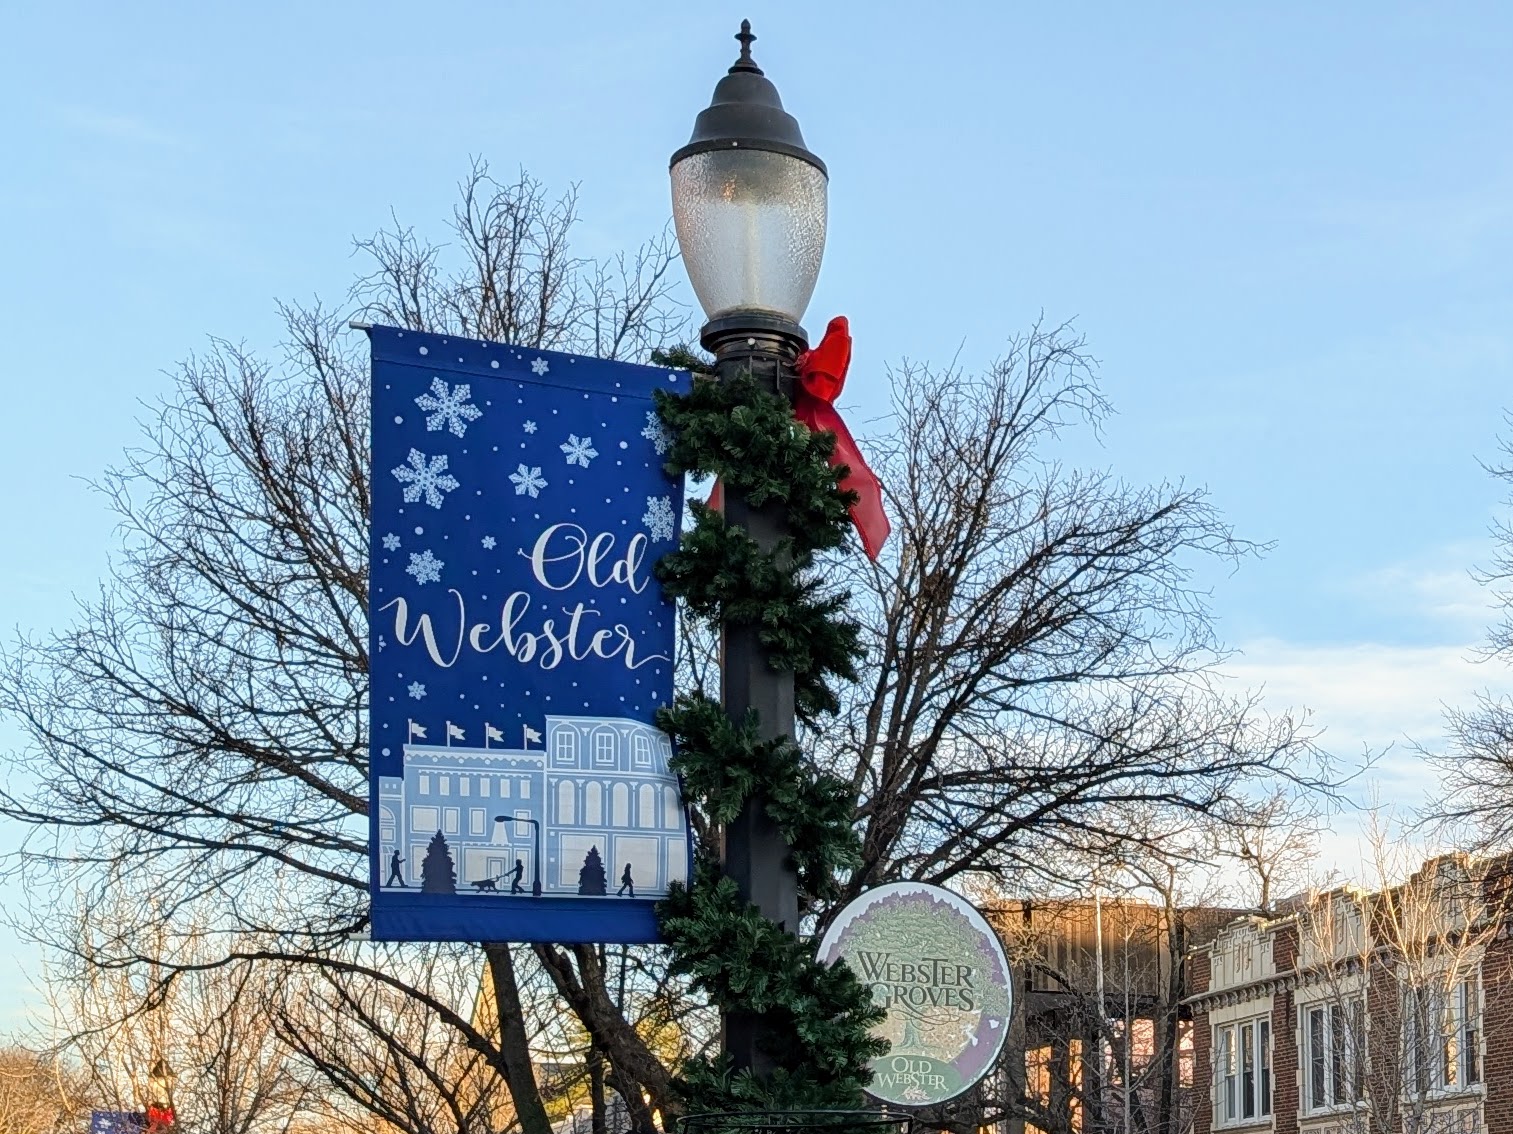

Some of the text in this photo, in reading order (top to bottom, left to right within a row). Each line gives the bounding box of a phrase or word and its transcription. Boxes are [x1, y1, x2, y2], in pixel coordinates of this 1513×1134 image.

[518, 523, 650, 594] Old
[379, 588, 671, 669] Webster
[857, 951, 974, 988] WEBSTER
[877, 1072, 949, 1091] WEBSTER
[892, 1056, 932, 1074] OLD
